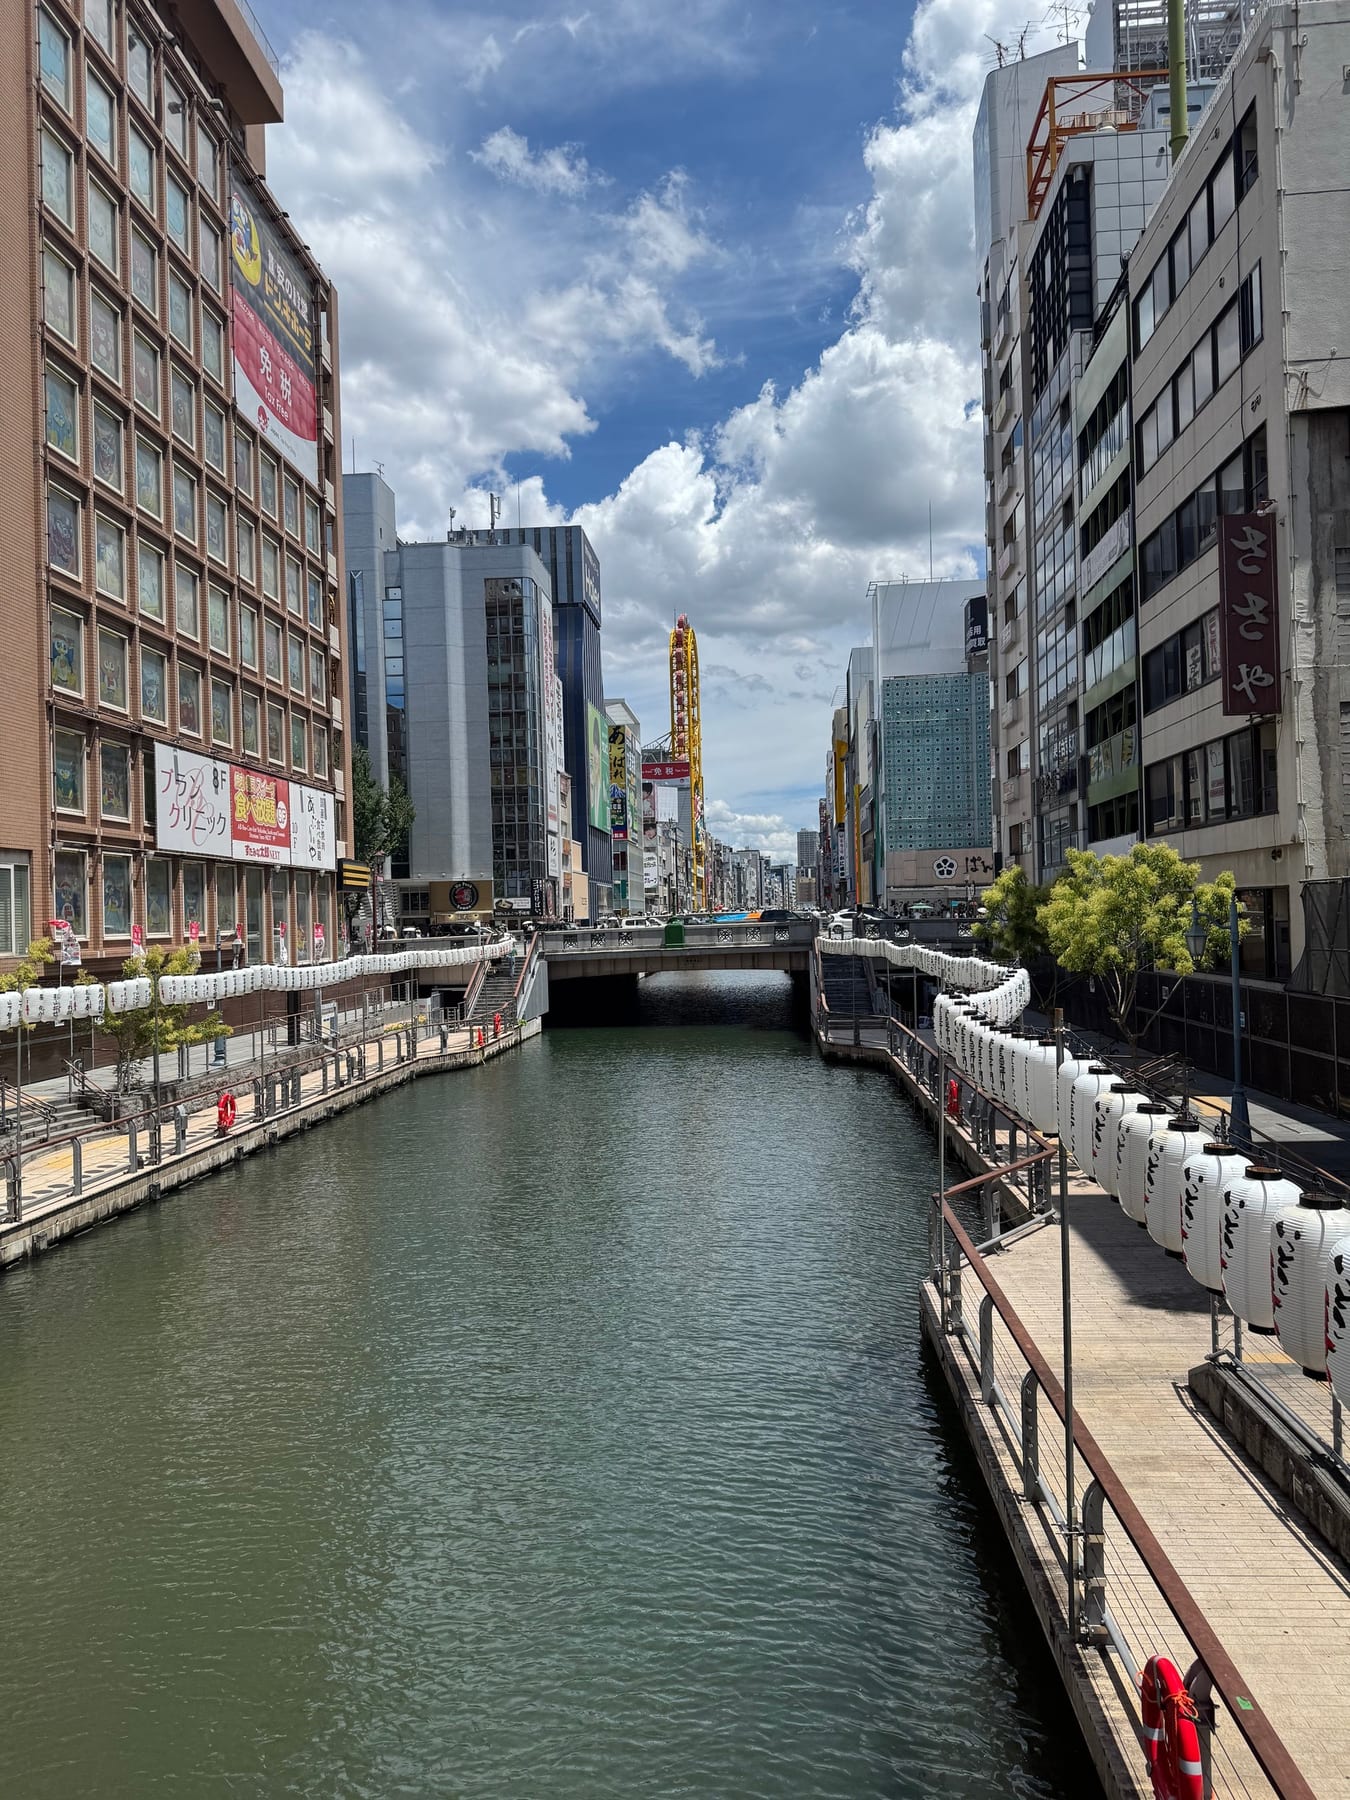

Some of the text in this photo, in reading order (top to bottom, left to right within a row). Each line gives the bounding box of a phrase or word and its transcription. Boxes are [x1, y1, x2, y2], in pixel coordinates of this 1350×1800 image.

[1230, 526, 1274, 704] ささや
[161, 768, 201, 799] ブラン
[212, 767, 227, 790] 8F
[169, 803, 227, 836] クリニック
